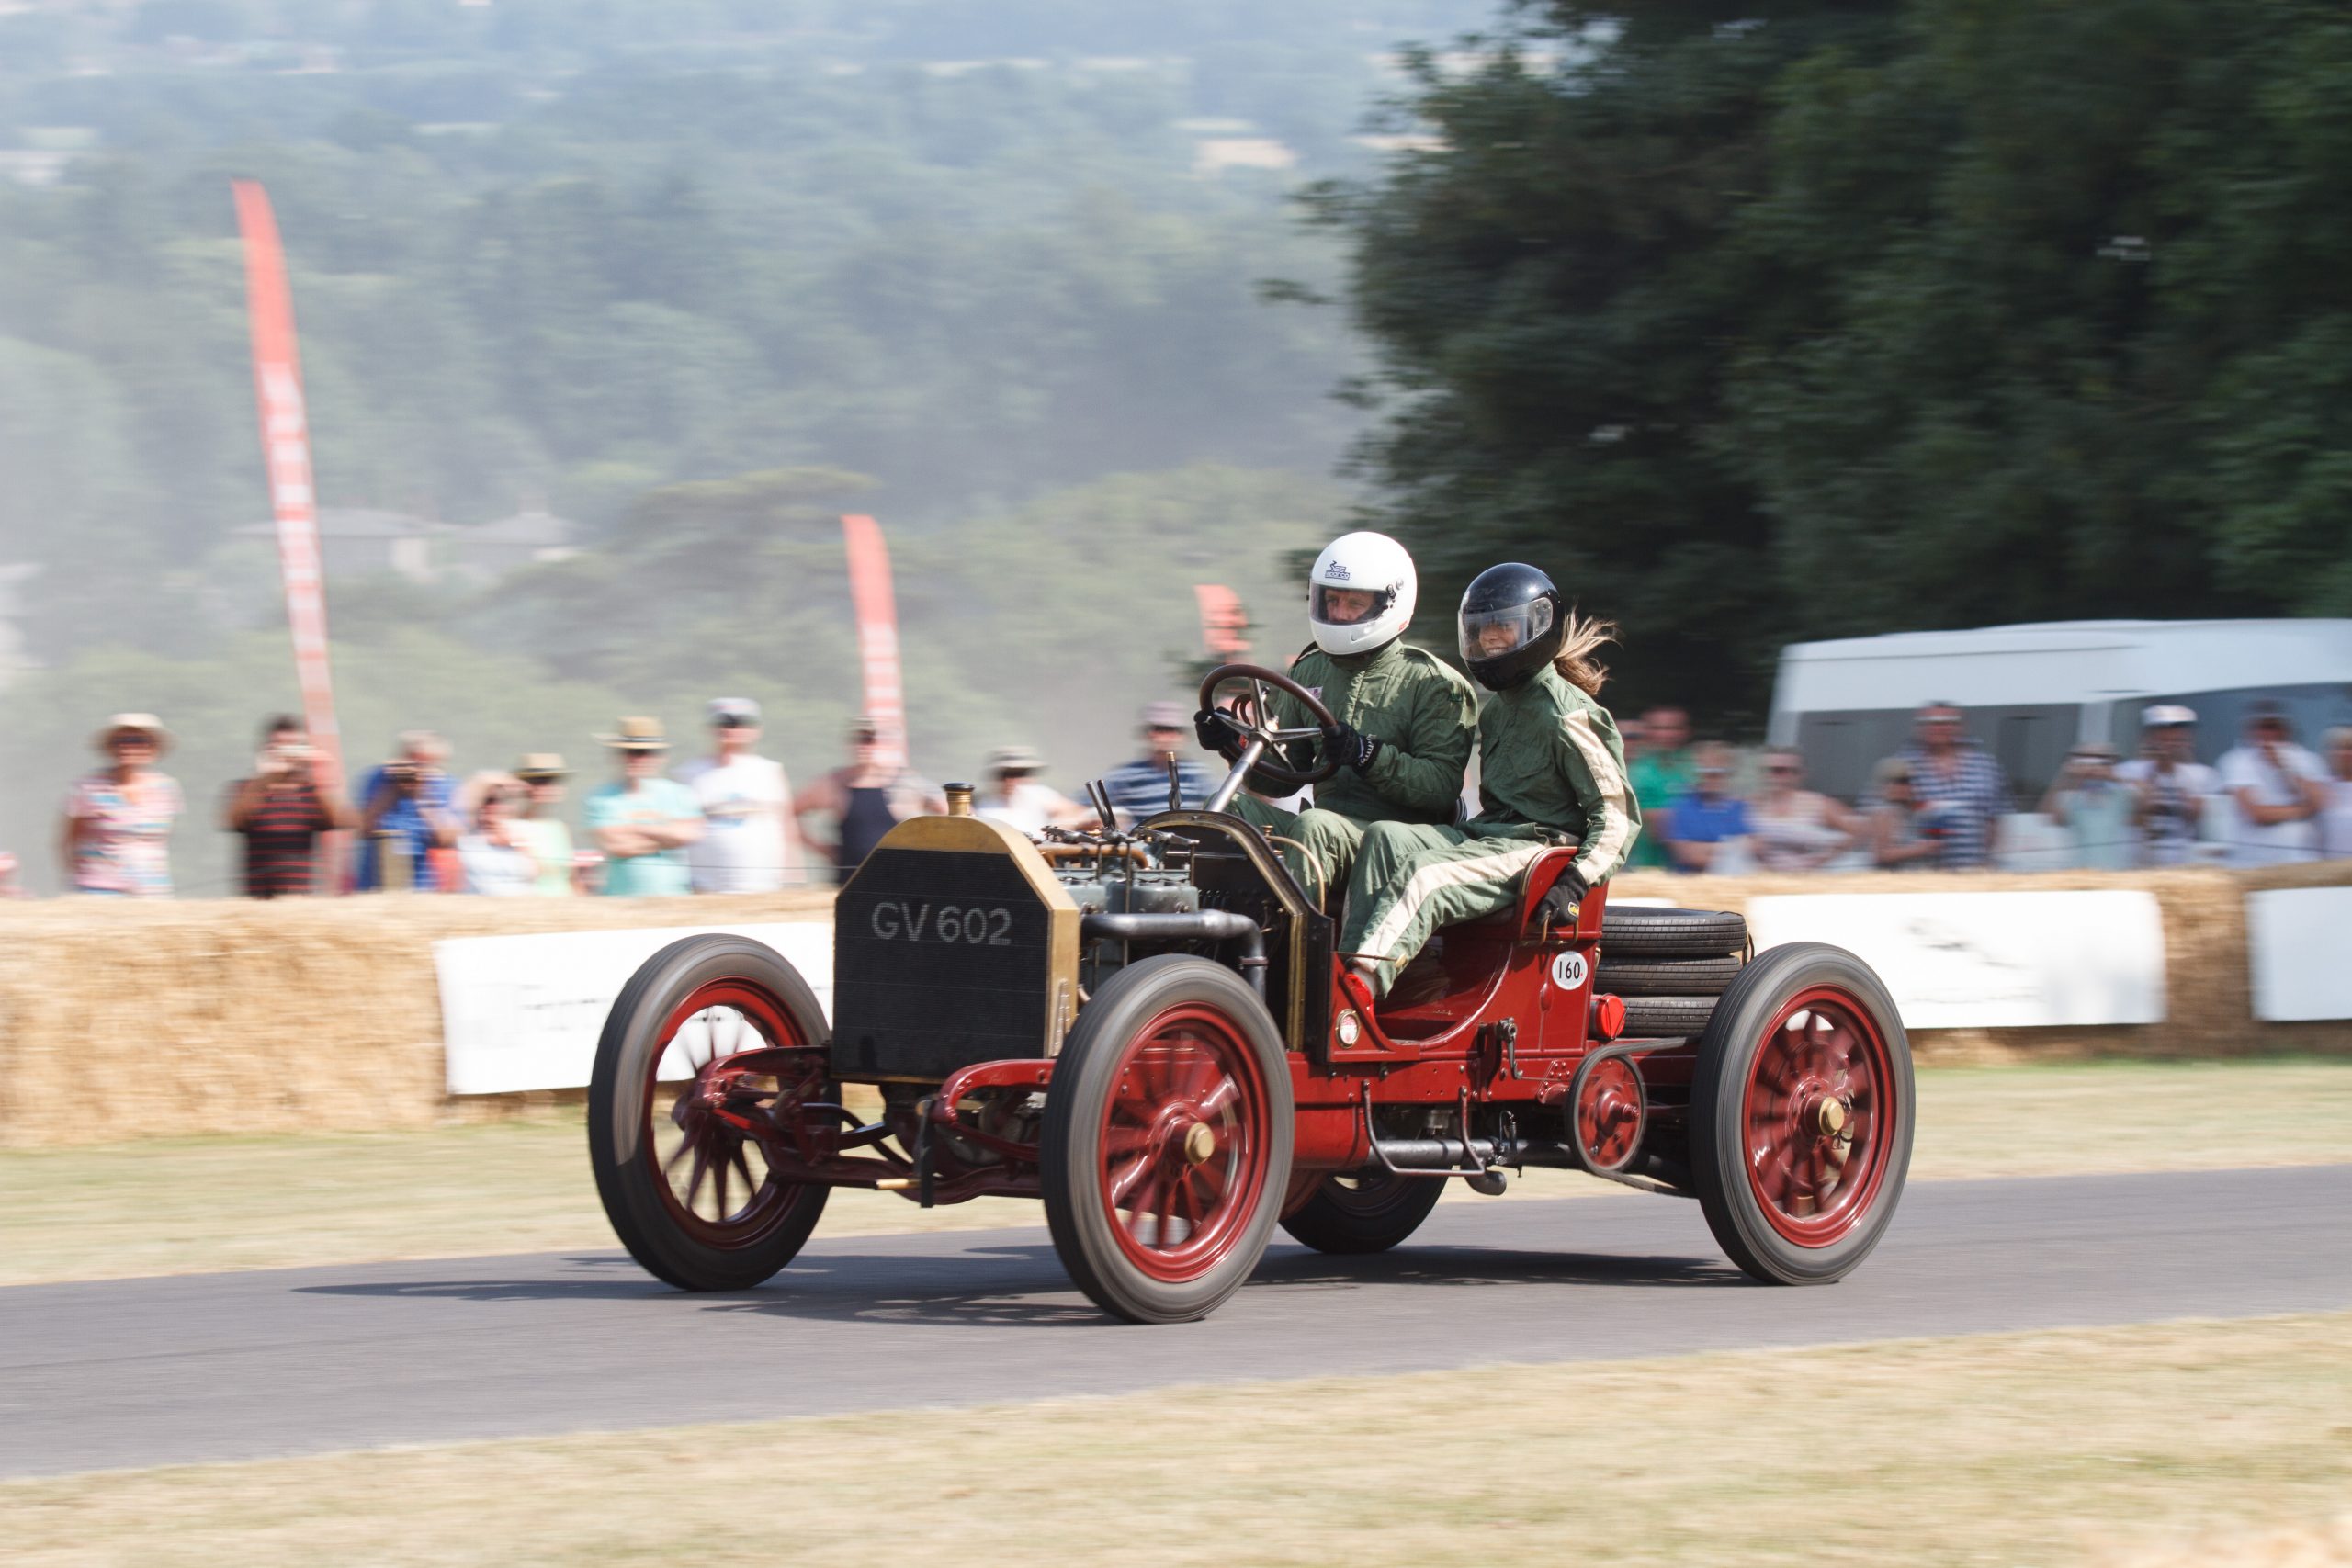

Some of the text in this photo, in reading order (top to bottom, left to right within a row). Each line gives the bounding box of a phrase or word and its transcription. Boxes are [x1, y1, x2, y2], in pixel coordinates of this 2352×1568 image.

[872, 902, 1012, 945] GV 602
[1559, 961, 1580, 980] 160
